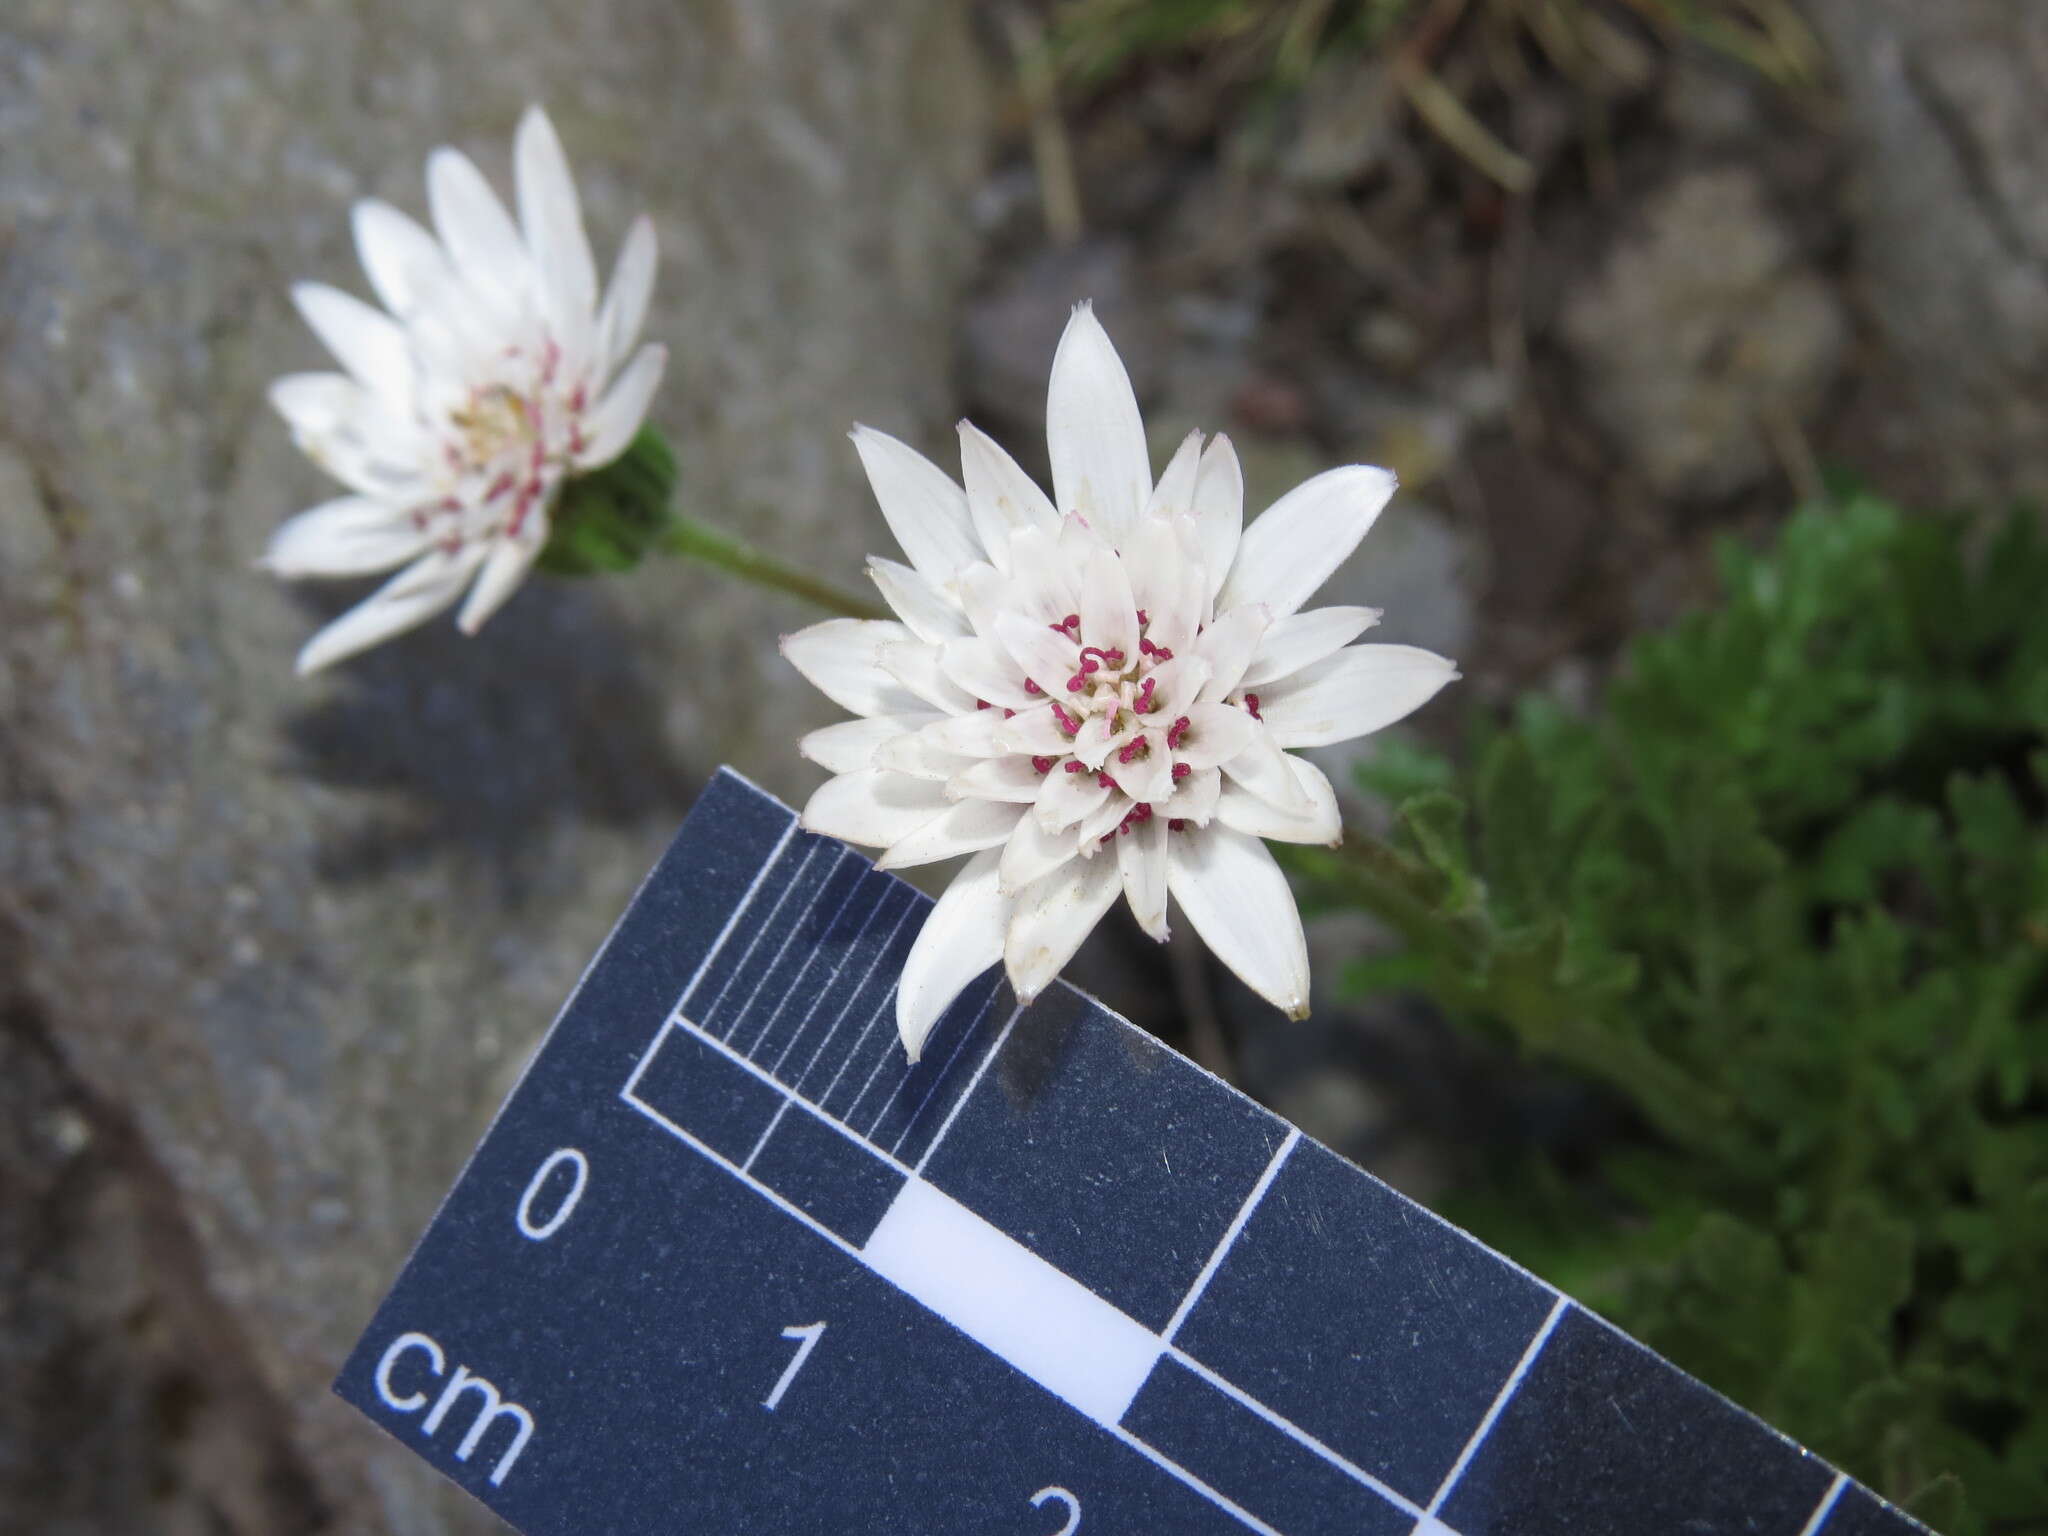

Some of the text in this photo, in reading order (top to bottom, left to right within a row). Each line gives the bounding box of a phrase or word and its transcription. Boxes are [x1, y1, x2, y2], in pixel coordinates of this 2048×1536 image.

[516, 1147, 589, 1241] 0
[765, 1320, 827, 1410] 1
[375, 1331, 535, 1486] cm
